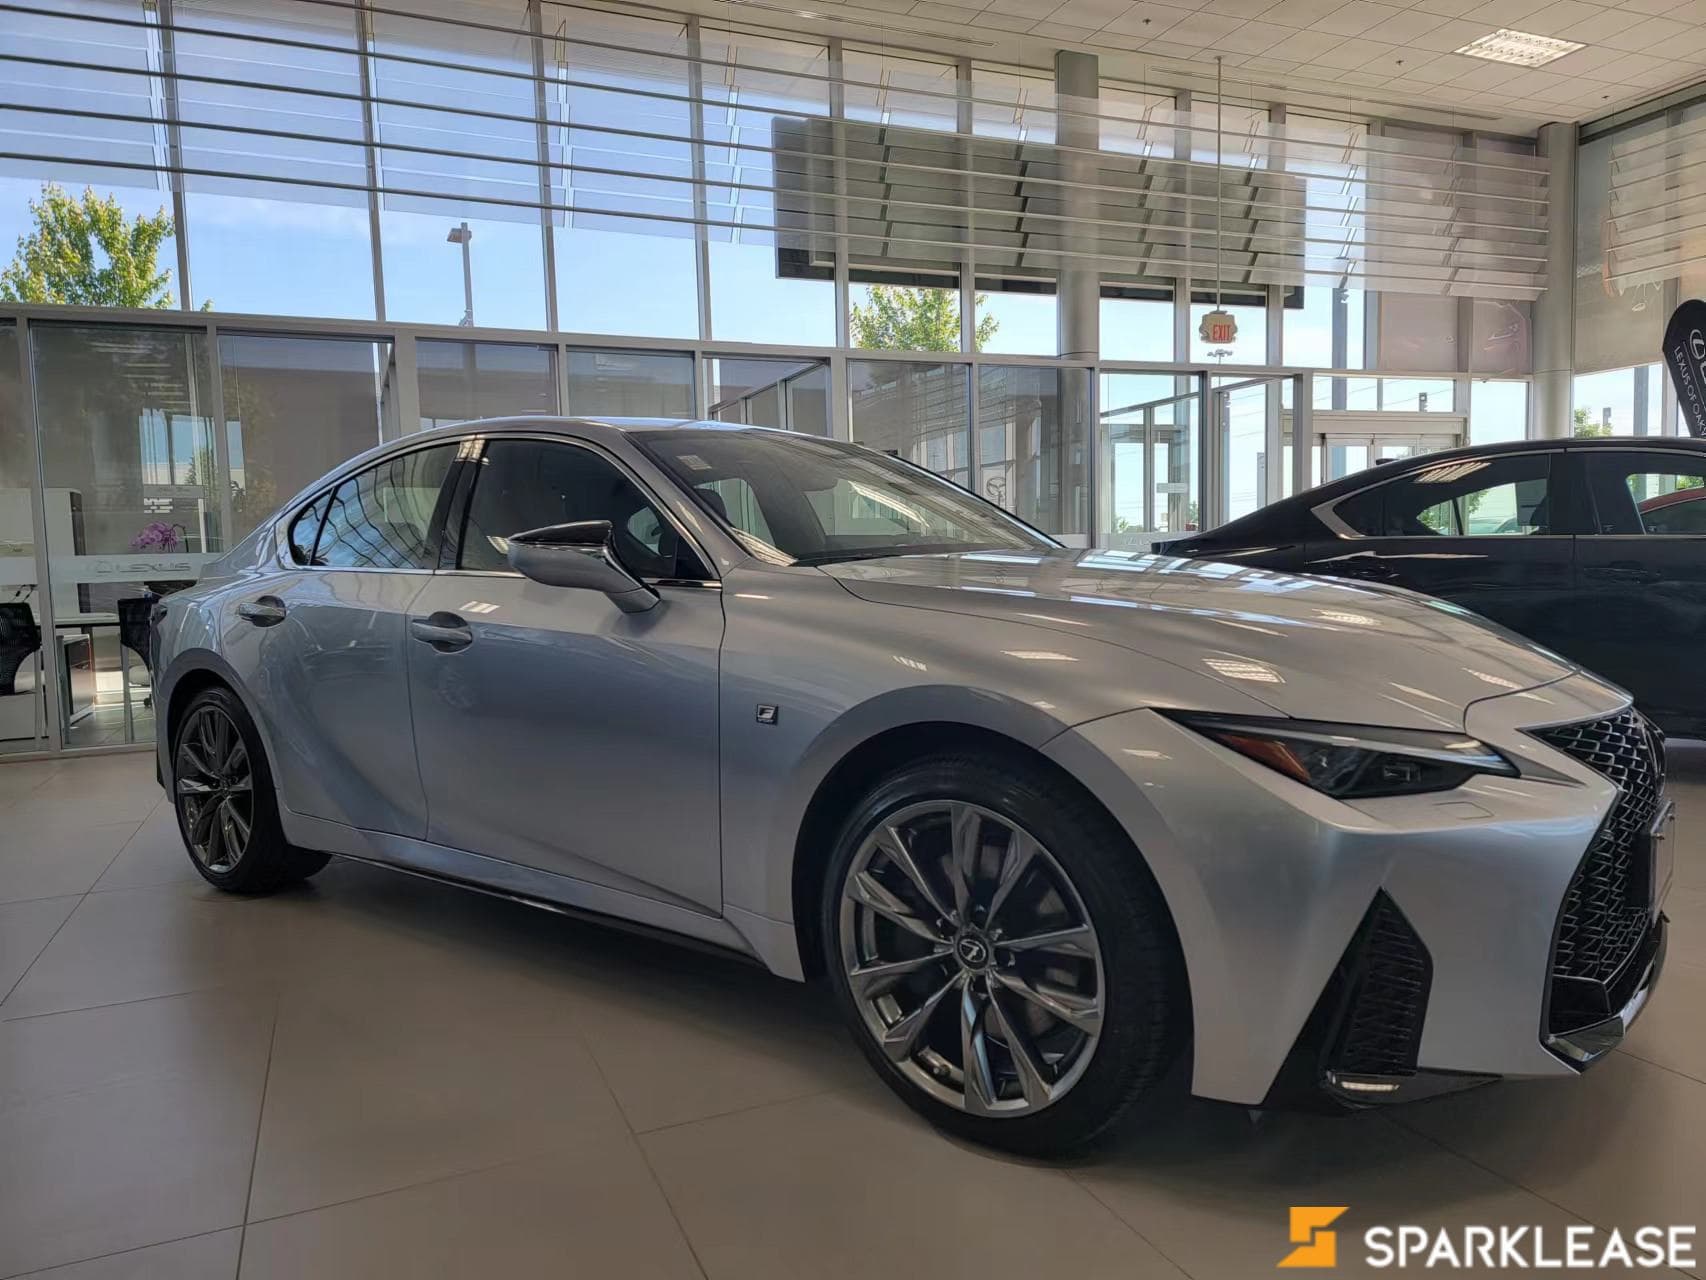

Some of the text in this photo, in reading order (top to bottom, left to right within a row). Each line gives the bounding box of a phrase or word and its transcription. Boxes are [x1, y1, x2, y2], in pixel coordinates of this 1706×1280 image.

[1212, 324, 1231, 341] EXIT
[1674, 346, 1691, 385] LEXUS
[1687, 384, 1697, 401] OF
